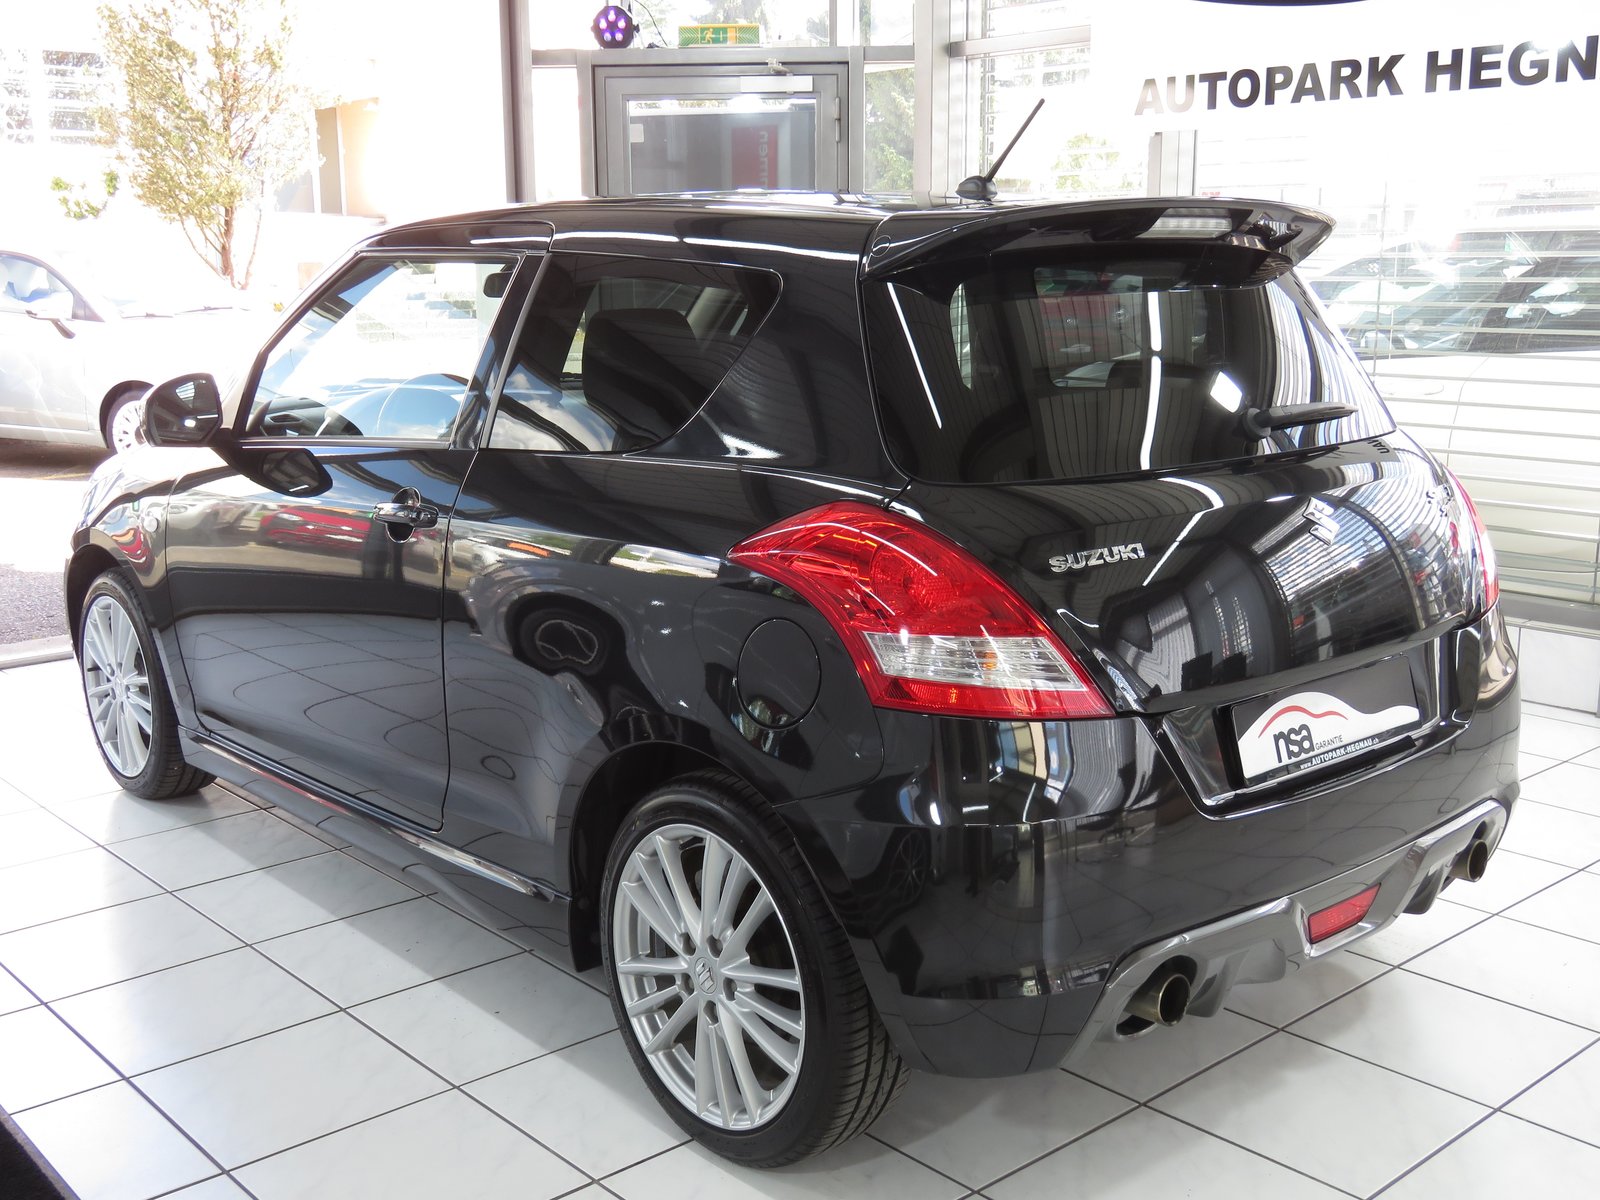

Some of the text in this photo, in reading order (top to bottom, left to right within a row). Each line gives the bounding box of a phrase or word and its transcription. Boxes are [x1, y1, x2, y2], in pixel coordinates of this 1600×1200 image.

[1134, 53, 1405, 116] AUTOPARK
[1048, 542, 1146, 573] SUZUKI
[1273, 723, 1344, 764] nsa GARANTIE
[1300, 737, 1380, 770] www.AUTOPARK-HEGNAU.ch
